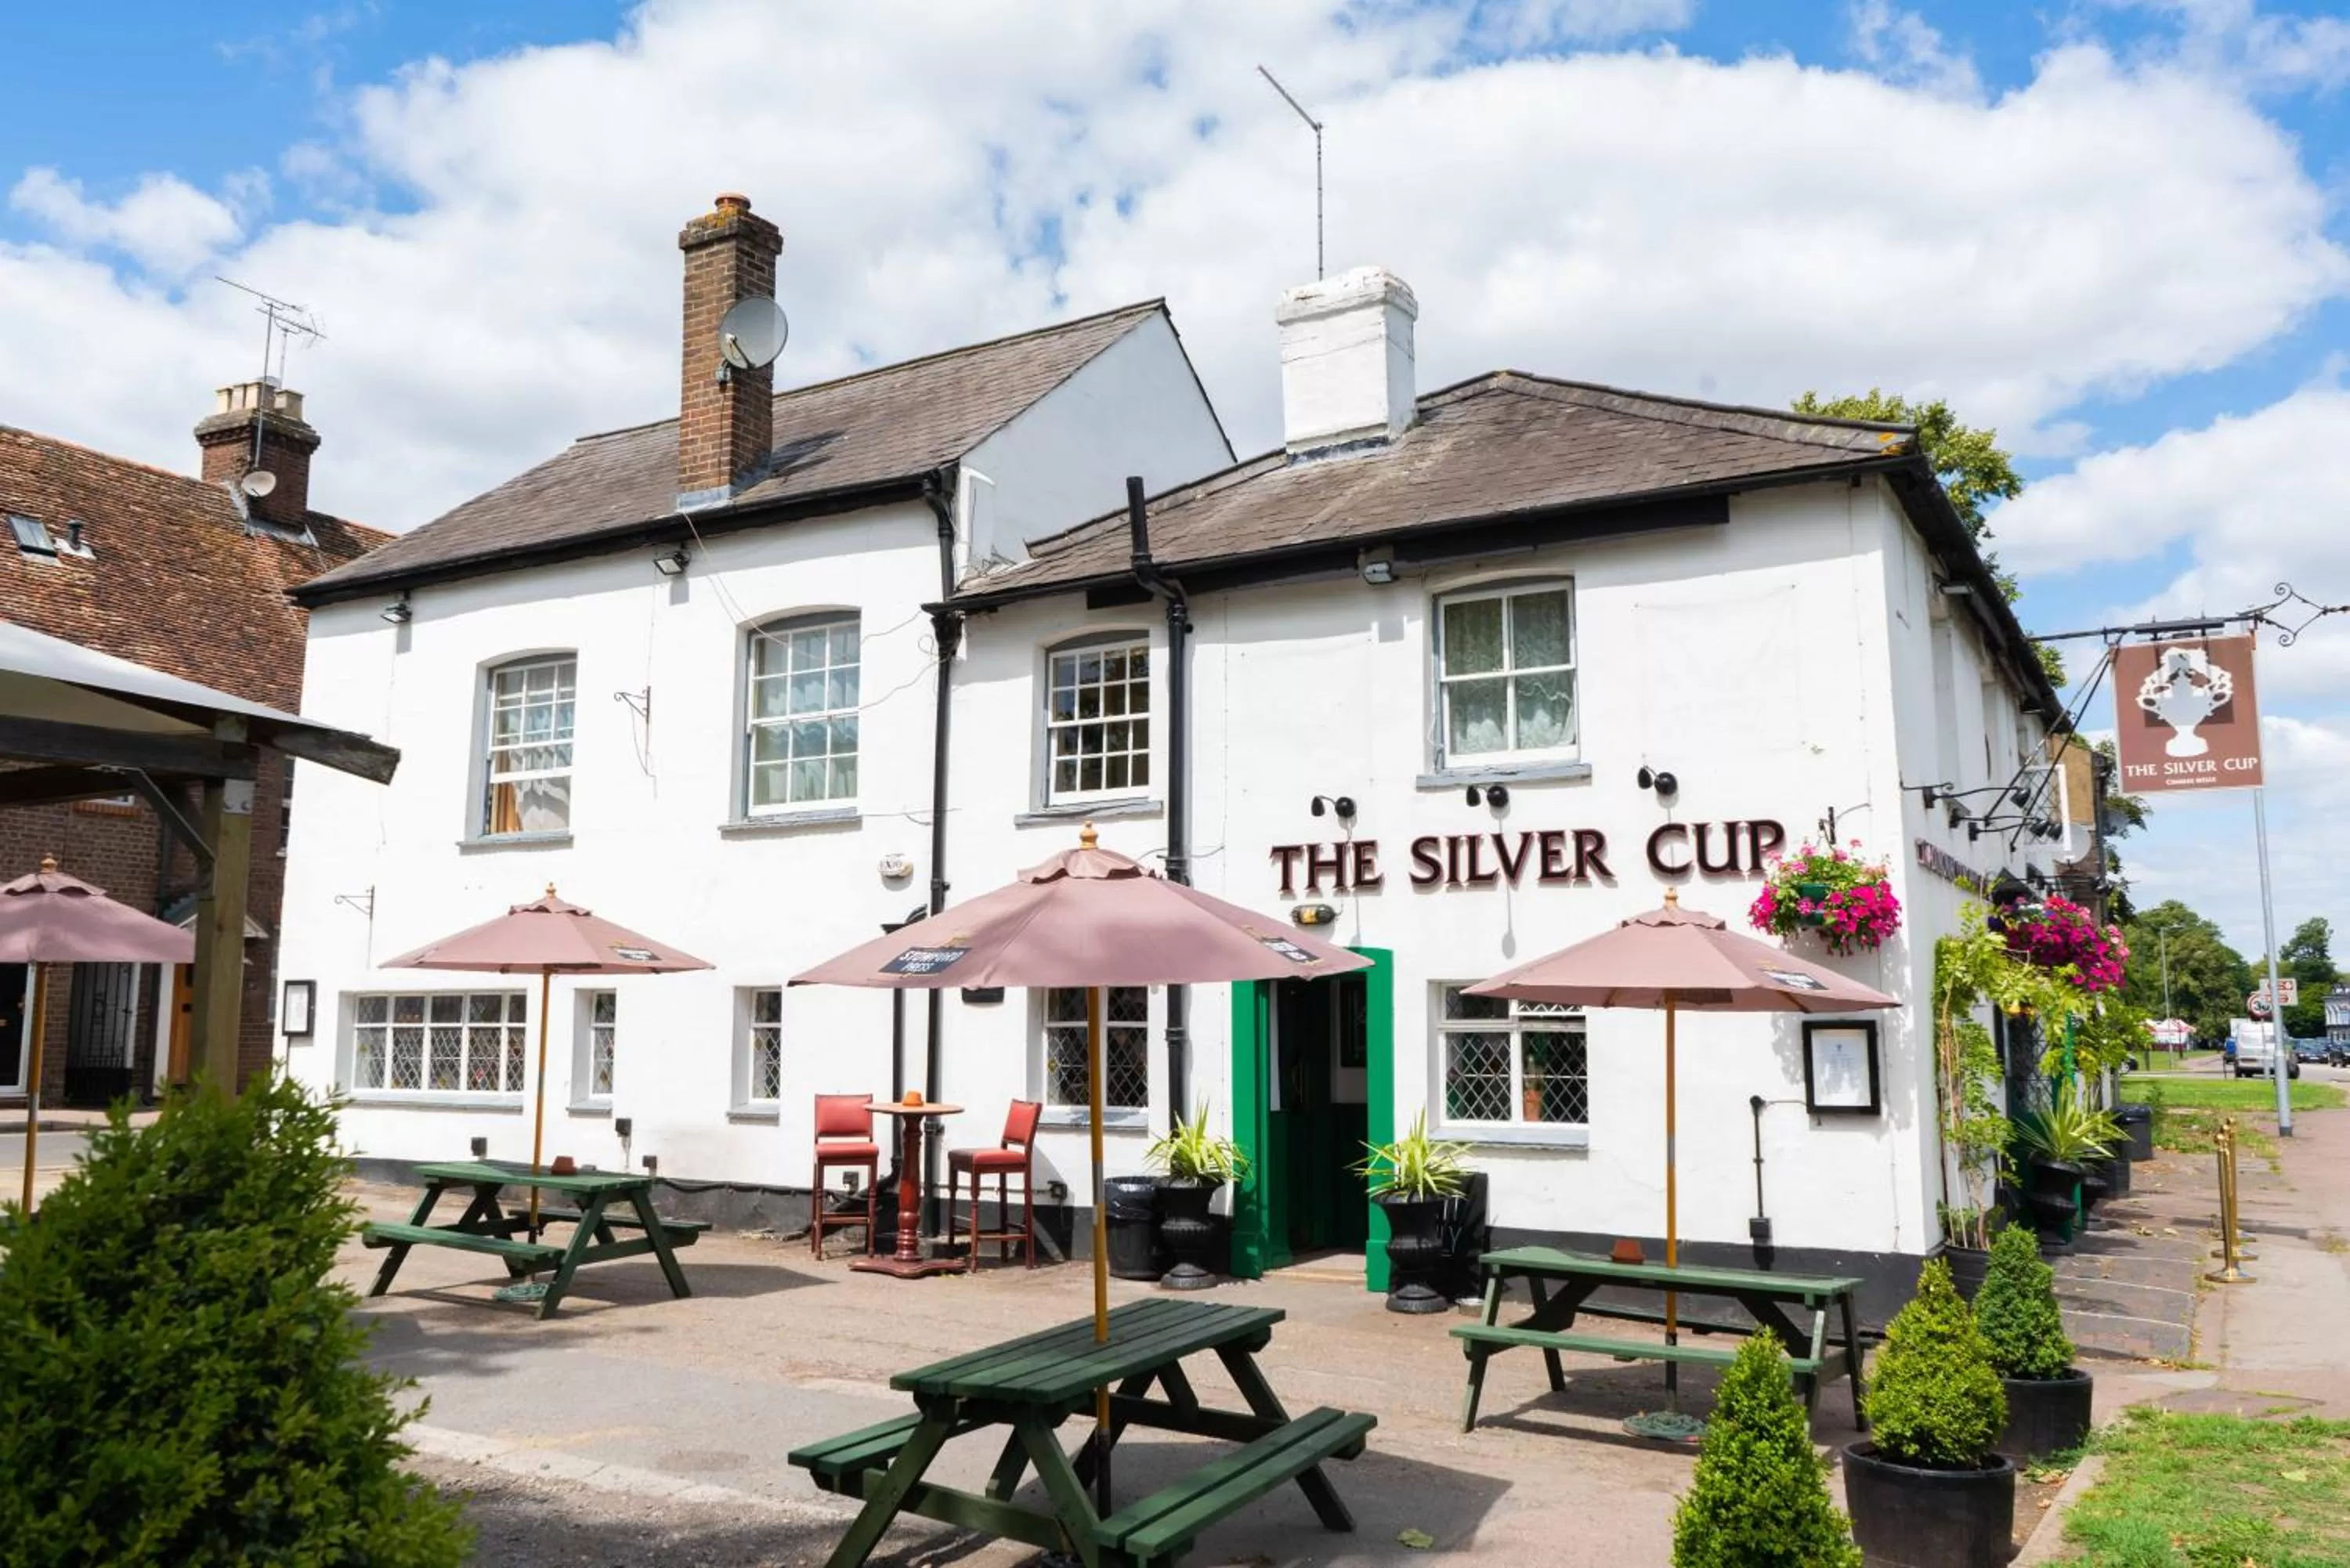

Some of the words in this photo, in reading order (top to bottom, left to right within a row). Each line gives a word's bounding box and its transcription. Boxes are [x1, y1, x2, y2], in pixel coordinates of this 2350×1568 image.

[2125, 764, 2157, 777] THE
[2164, 761, 2217, 775] SILVER
[2223, 757, 2258, 771] CUP
[1270, 840, 1384, 891] THE
[1409, 829, 1616, 885] SILVER
[1647, 819, 1786, 875] CUP
